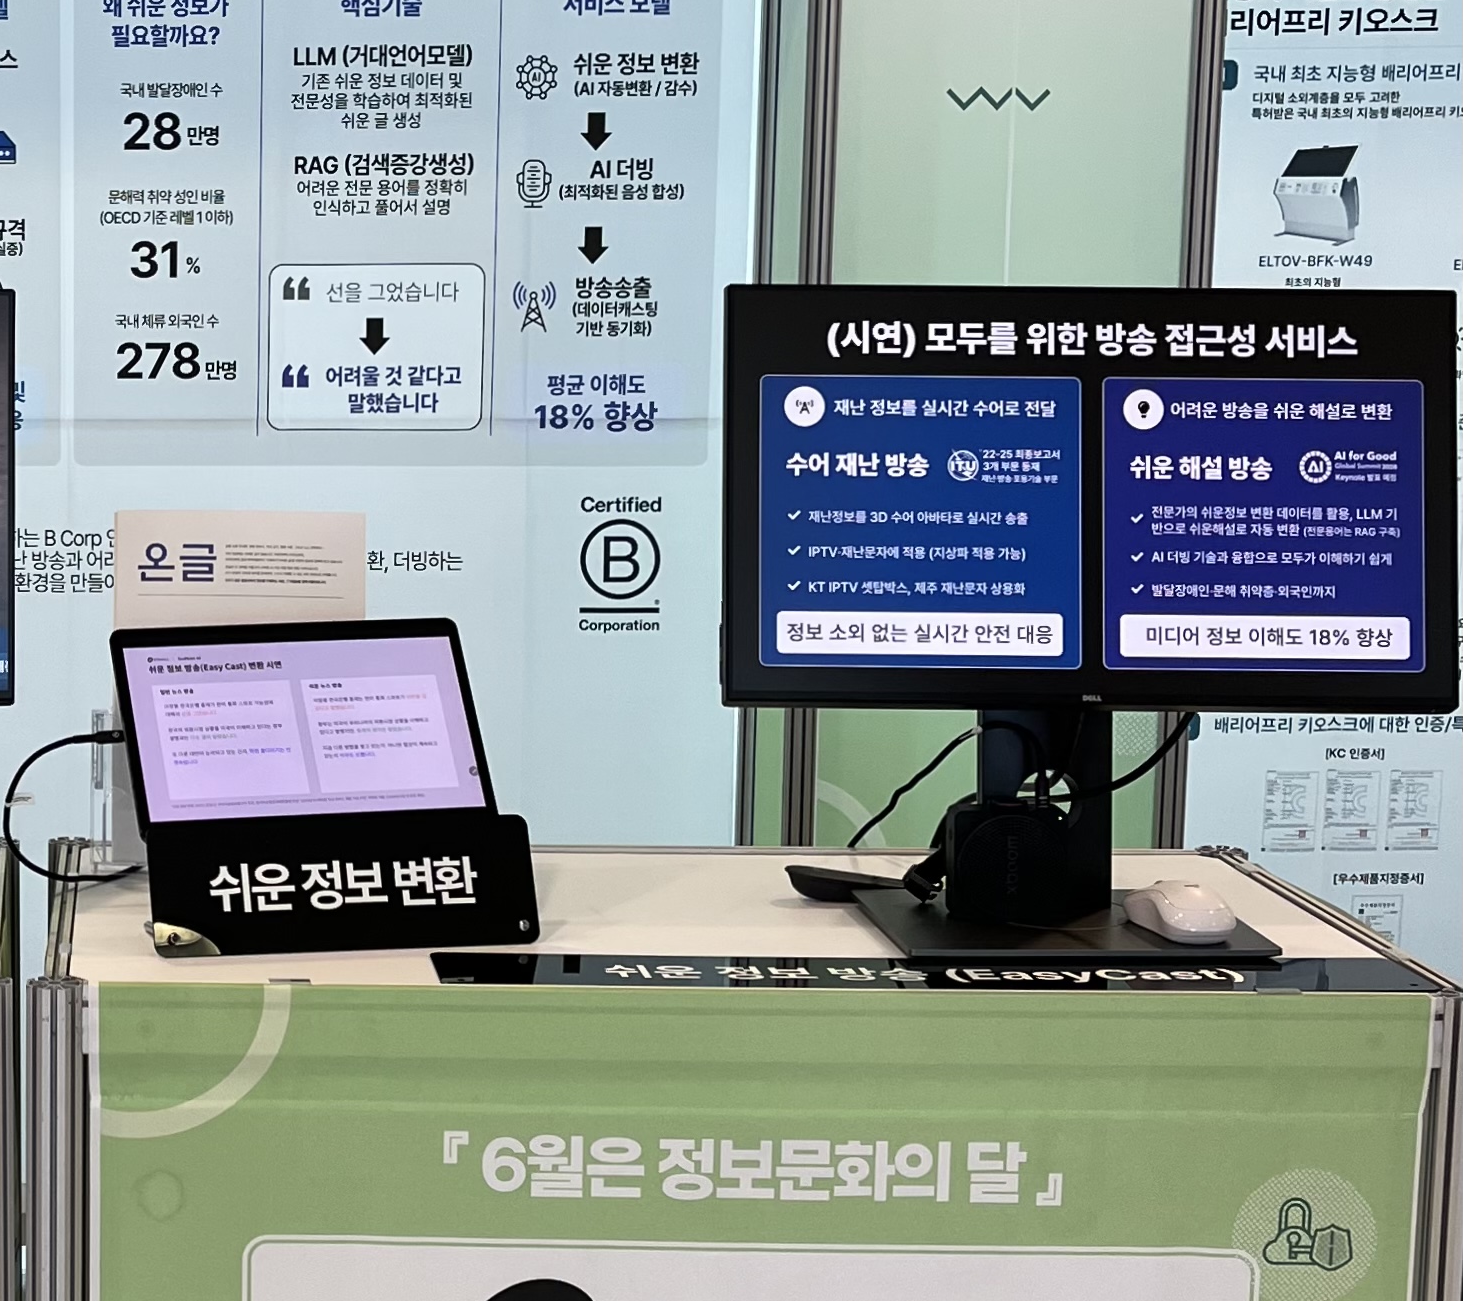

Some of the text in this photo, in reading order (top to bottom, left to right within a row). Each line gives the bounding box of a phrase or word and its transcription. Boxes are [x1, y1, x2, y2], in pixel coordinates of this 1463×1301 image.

[294, 44, 472, 68] LLM (거대언어모델)
[1254, 63, 1460, 83] 국내 최초 지능형 배리어프리
[290, 91, 472, 110] 전문성을 학습하여 최적화된
[590, 159, 655, 182] AI 더빙
[131, 241, 200, 278] 31 %
[1259, 255, 1372, 267] ELTOV-BFK-W49
[327, 282, 459, 303] 선을 그었습니다
[827, 320, 1358, 358] (시연) 모두를 위한 방송 접근성 서비스
[117, 342, 236, 380] 278 만명
[535, 401, 658, 432] 18% 향상
[1334, 451, 1397, 461] AI for Good
[580, 497, 662, 514] Certified
[44, 530, 102, 551] B Corp
[138, 543, 217, 582] 온글
[809, 581, 1025, 596] KT IPTV 셋탑박스, 제주 재난문자 상용화
[579, 619, 659, 633] Corporation
[787, 623, 1053, 644] 정보 소외 없는 실시간 안전 대응
[1214, 716, 1410, 733] 배리어프리 키오스크에 대한
[1326, 748, 1385, 760] [KC 인증서]
[209, 856, 478, 913] 쉬운 정보 변환
[1333, 873, 1424, 885] [우수제품지정증서]
[604, 963, 1245, 986] 쉬운 정보 방송 (EasyCast)
